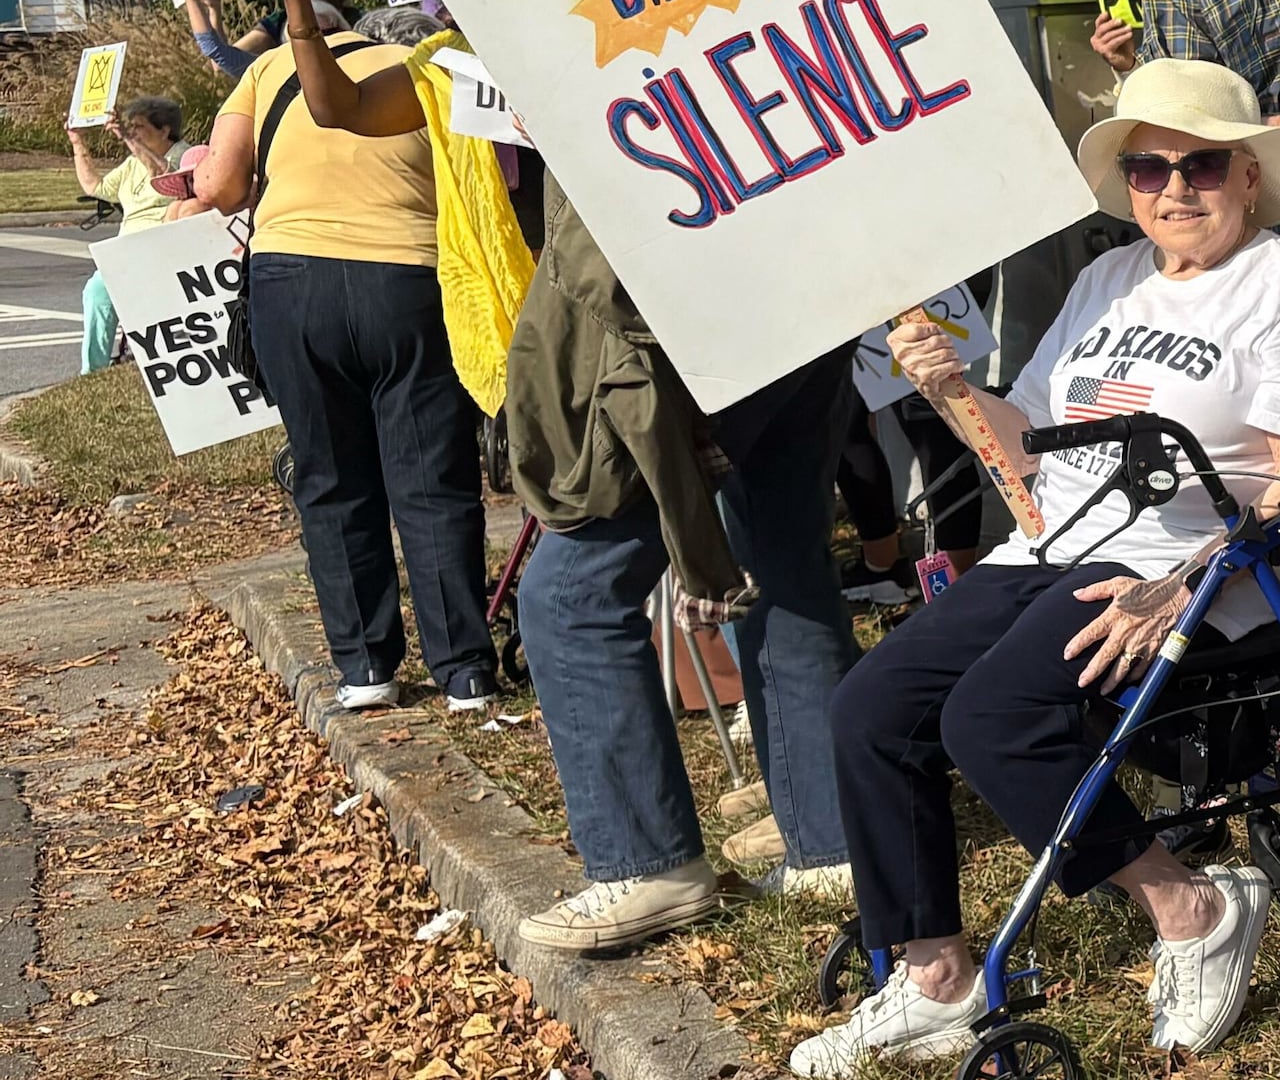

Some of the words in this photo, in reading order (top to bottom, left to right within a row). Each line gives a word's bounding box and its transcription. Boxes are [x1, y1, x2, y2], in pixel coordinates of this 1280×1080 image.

[127, 311, 217, 361] YES
[1107, 325, 1222, 381] KINGS
[1103, 360, 1136, 381] IN
